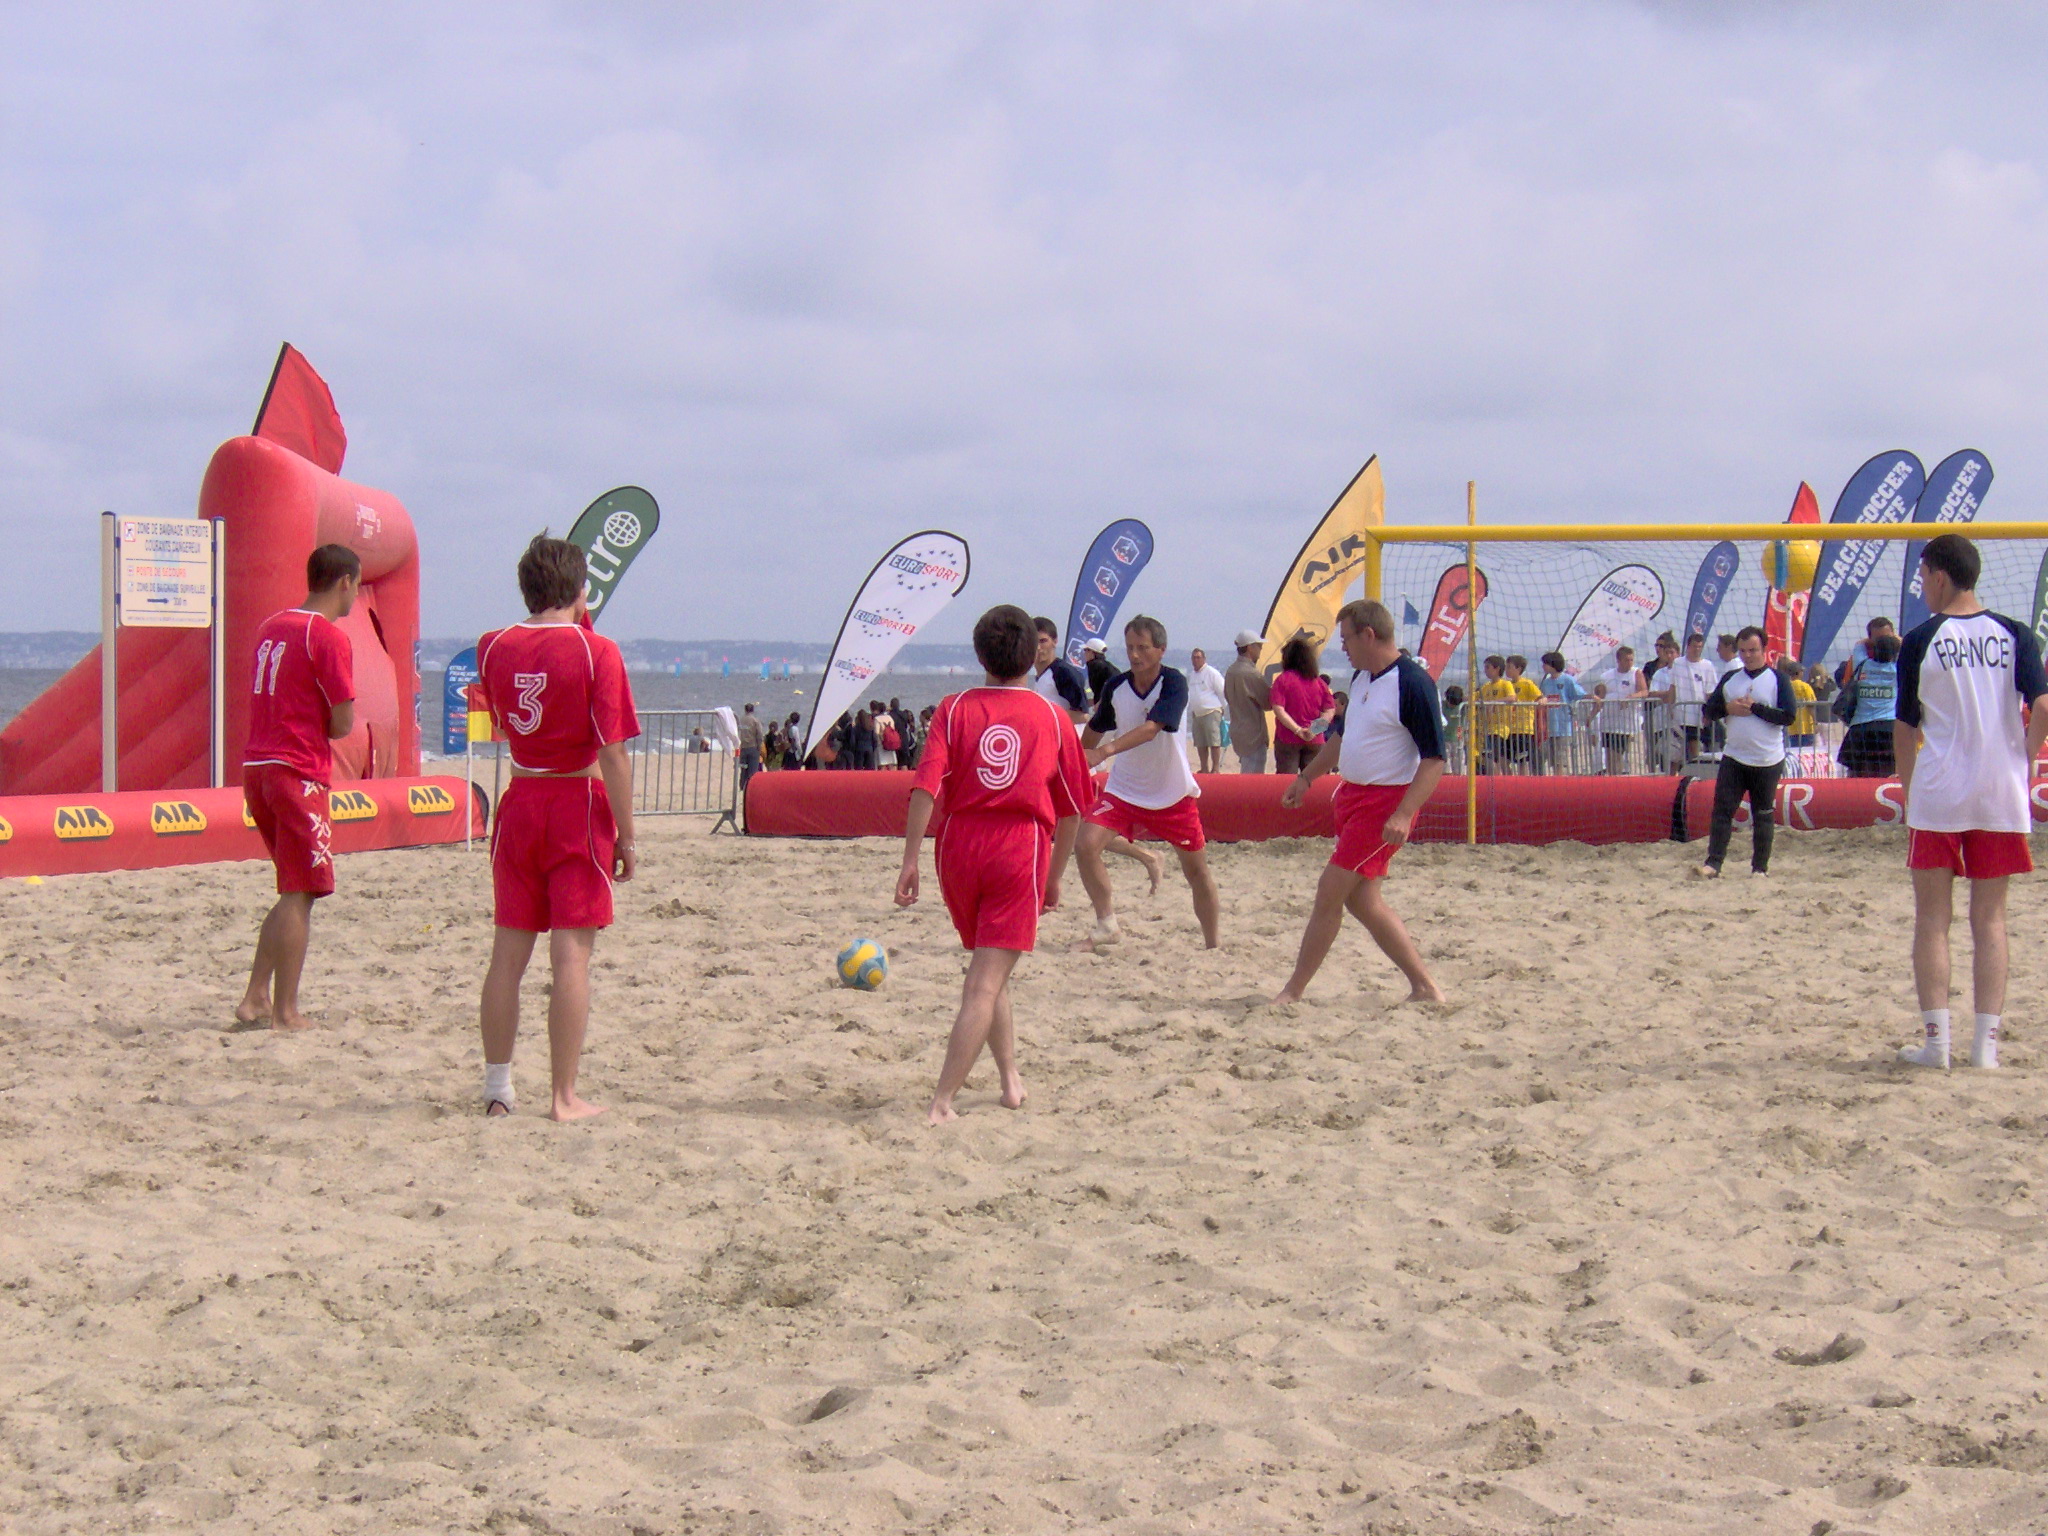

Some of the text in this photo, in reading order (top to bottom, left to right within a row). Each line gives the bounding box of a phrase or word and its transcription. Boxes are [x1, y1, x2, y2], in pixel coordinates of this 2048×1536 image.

[888, 554, 960, 583] EUROSPORT
[1933, 635, 2009, 672] FRANCE
[253, 639, 287, 696] 11
[507, 672, 548, 735] 3
[976, 724, 1021, 790] 9
[331, 791, 372, 812] AIR
[411, 786, 449, 806] AIR
[1092, 800, 1114, 816] 7
[57, 807, 108, 829] AIR
[154, 802, 201, 824] AIR
